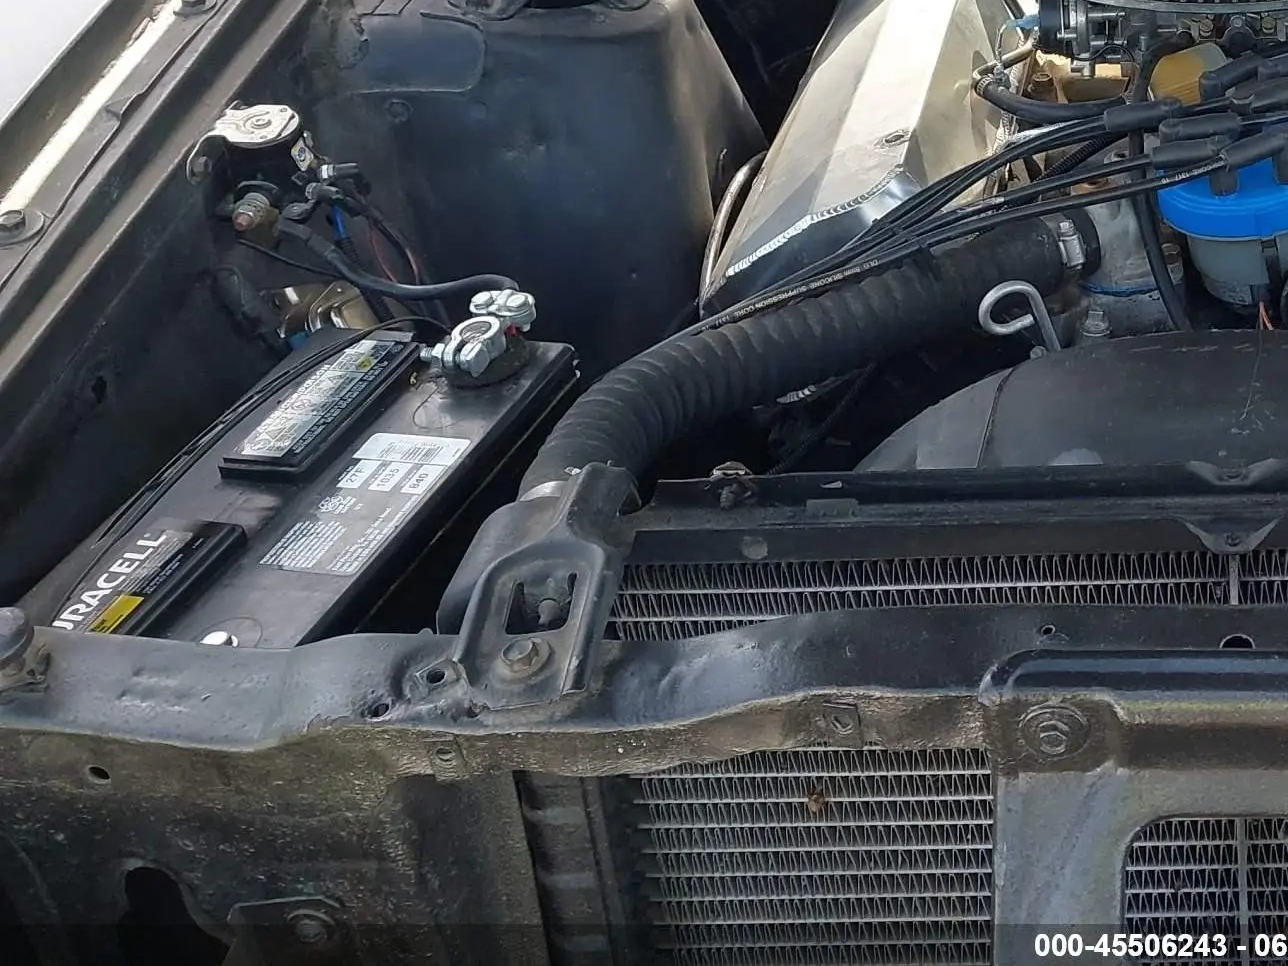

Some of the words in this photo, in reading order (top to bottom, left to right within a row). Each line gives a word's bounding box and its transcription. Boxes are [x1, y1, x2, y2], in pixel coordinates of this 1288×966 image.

[809, 272, 845, 290] SILICONE
[755, 286, 808, 308] SUPPRESSION
[734, 305, 755, 317] CORE
[345, 468, 365, 484] 27F
[376, 468, 401, 488] 1035
[52, 534, 167, 631] URACELL
